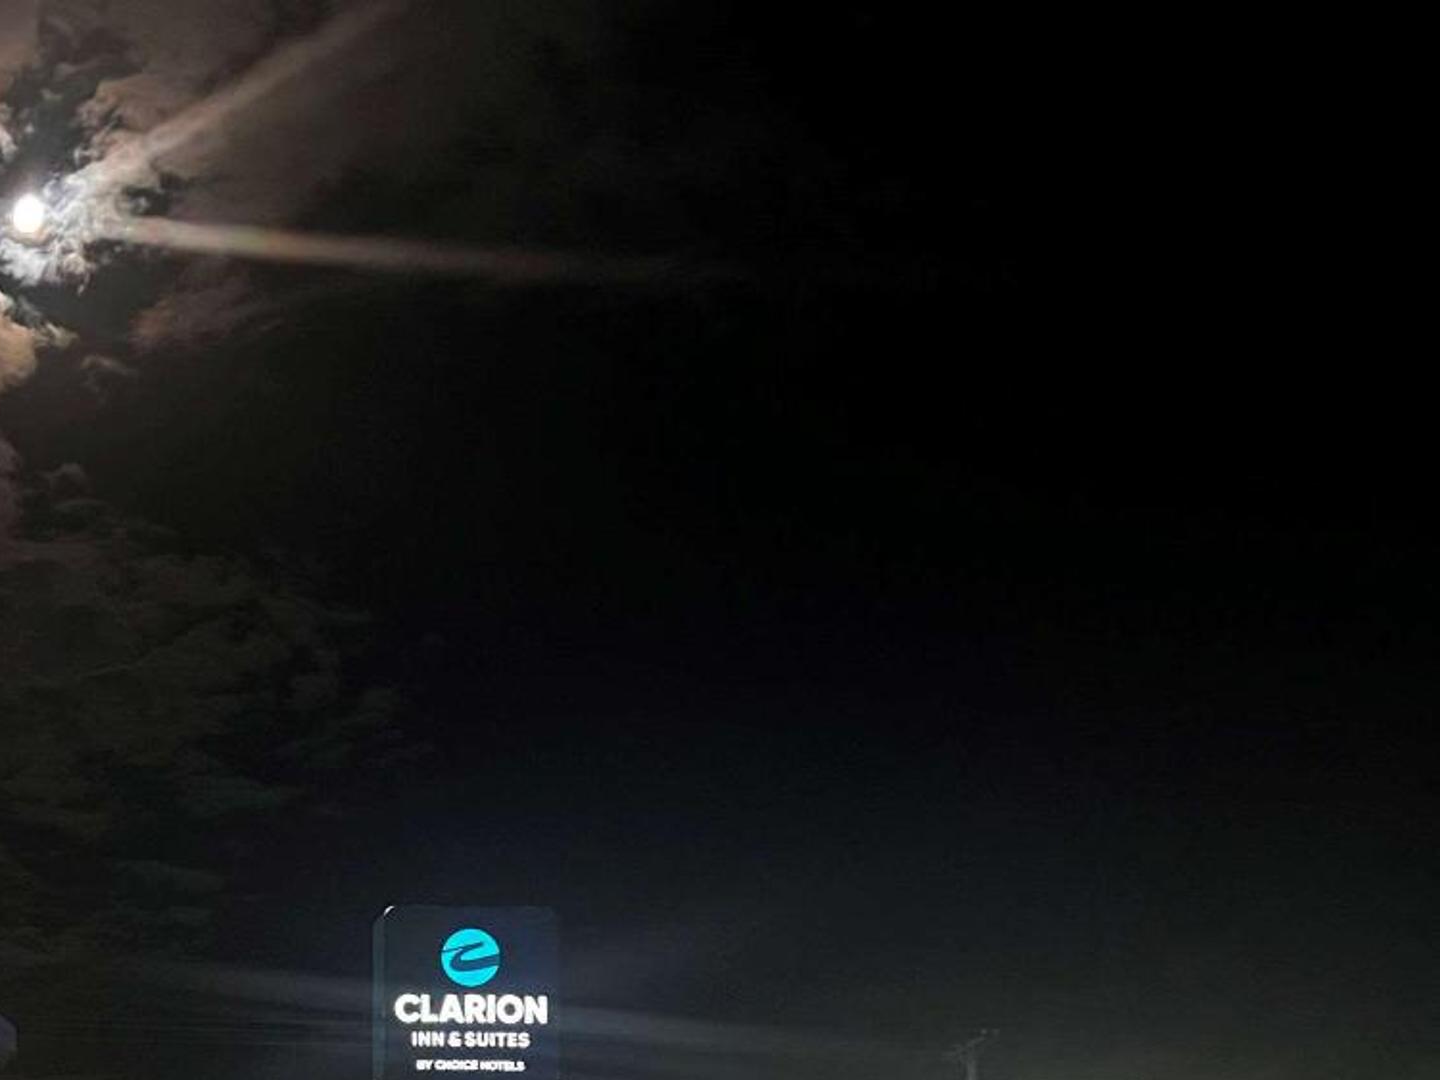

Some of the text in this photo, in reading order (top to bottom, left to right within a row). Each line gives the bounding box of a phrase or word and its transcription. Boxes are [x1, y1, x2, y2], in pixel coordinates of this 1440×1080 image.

[394, 994, 548, 1024] CLARION
[411, 1031, 531, 1048] INN & SUITES
[416, 1059, 526, 1072] BY CHOICE HOTELS
